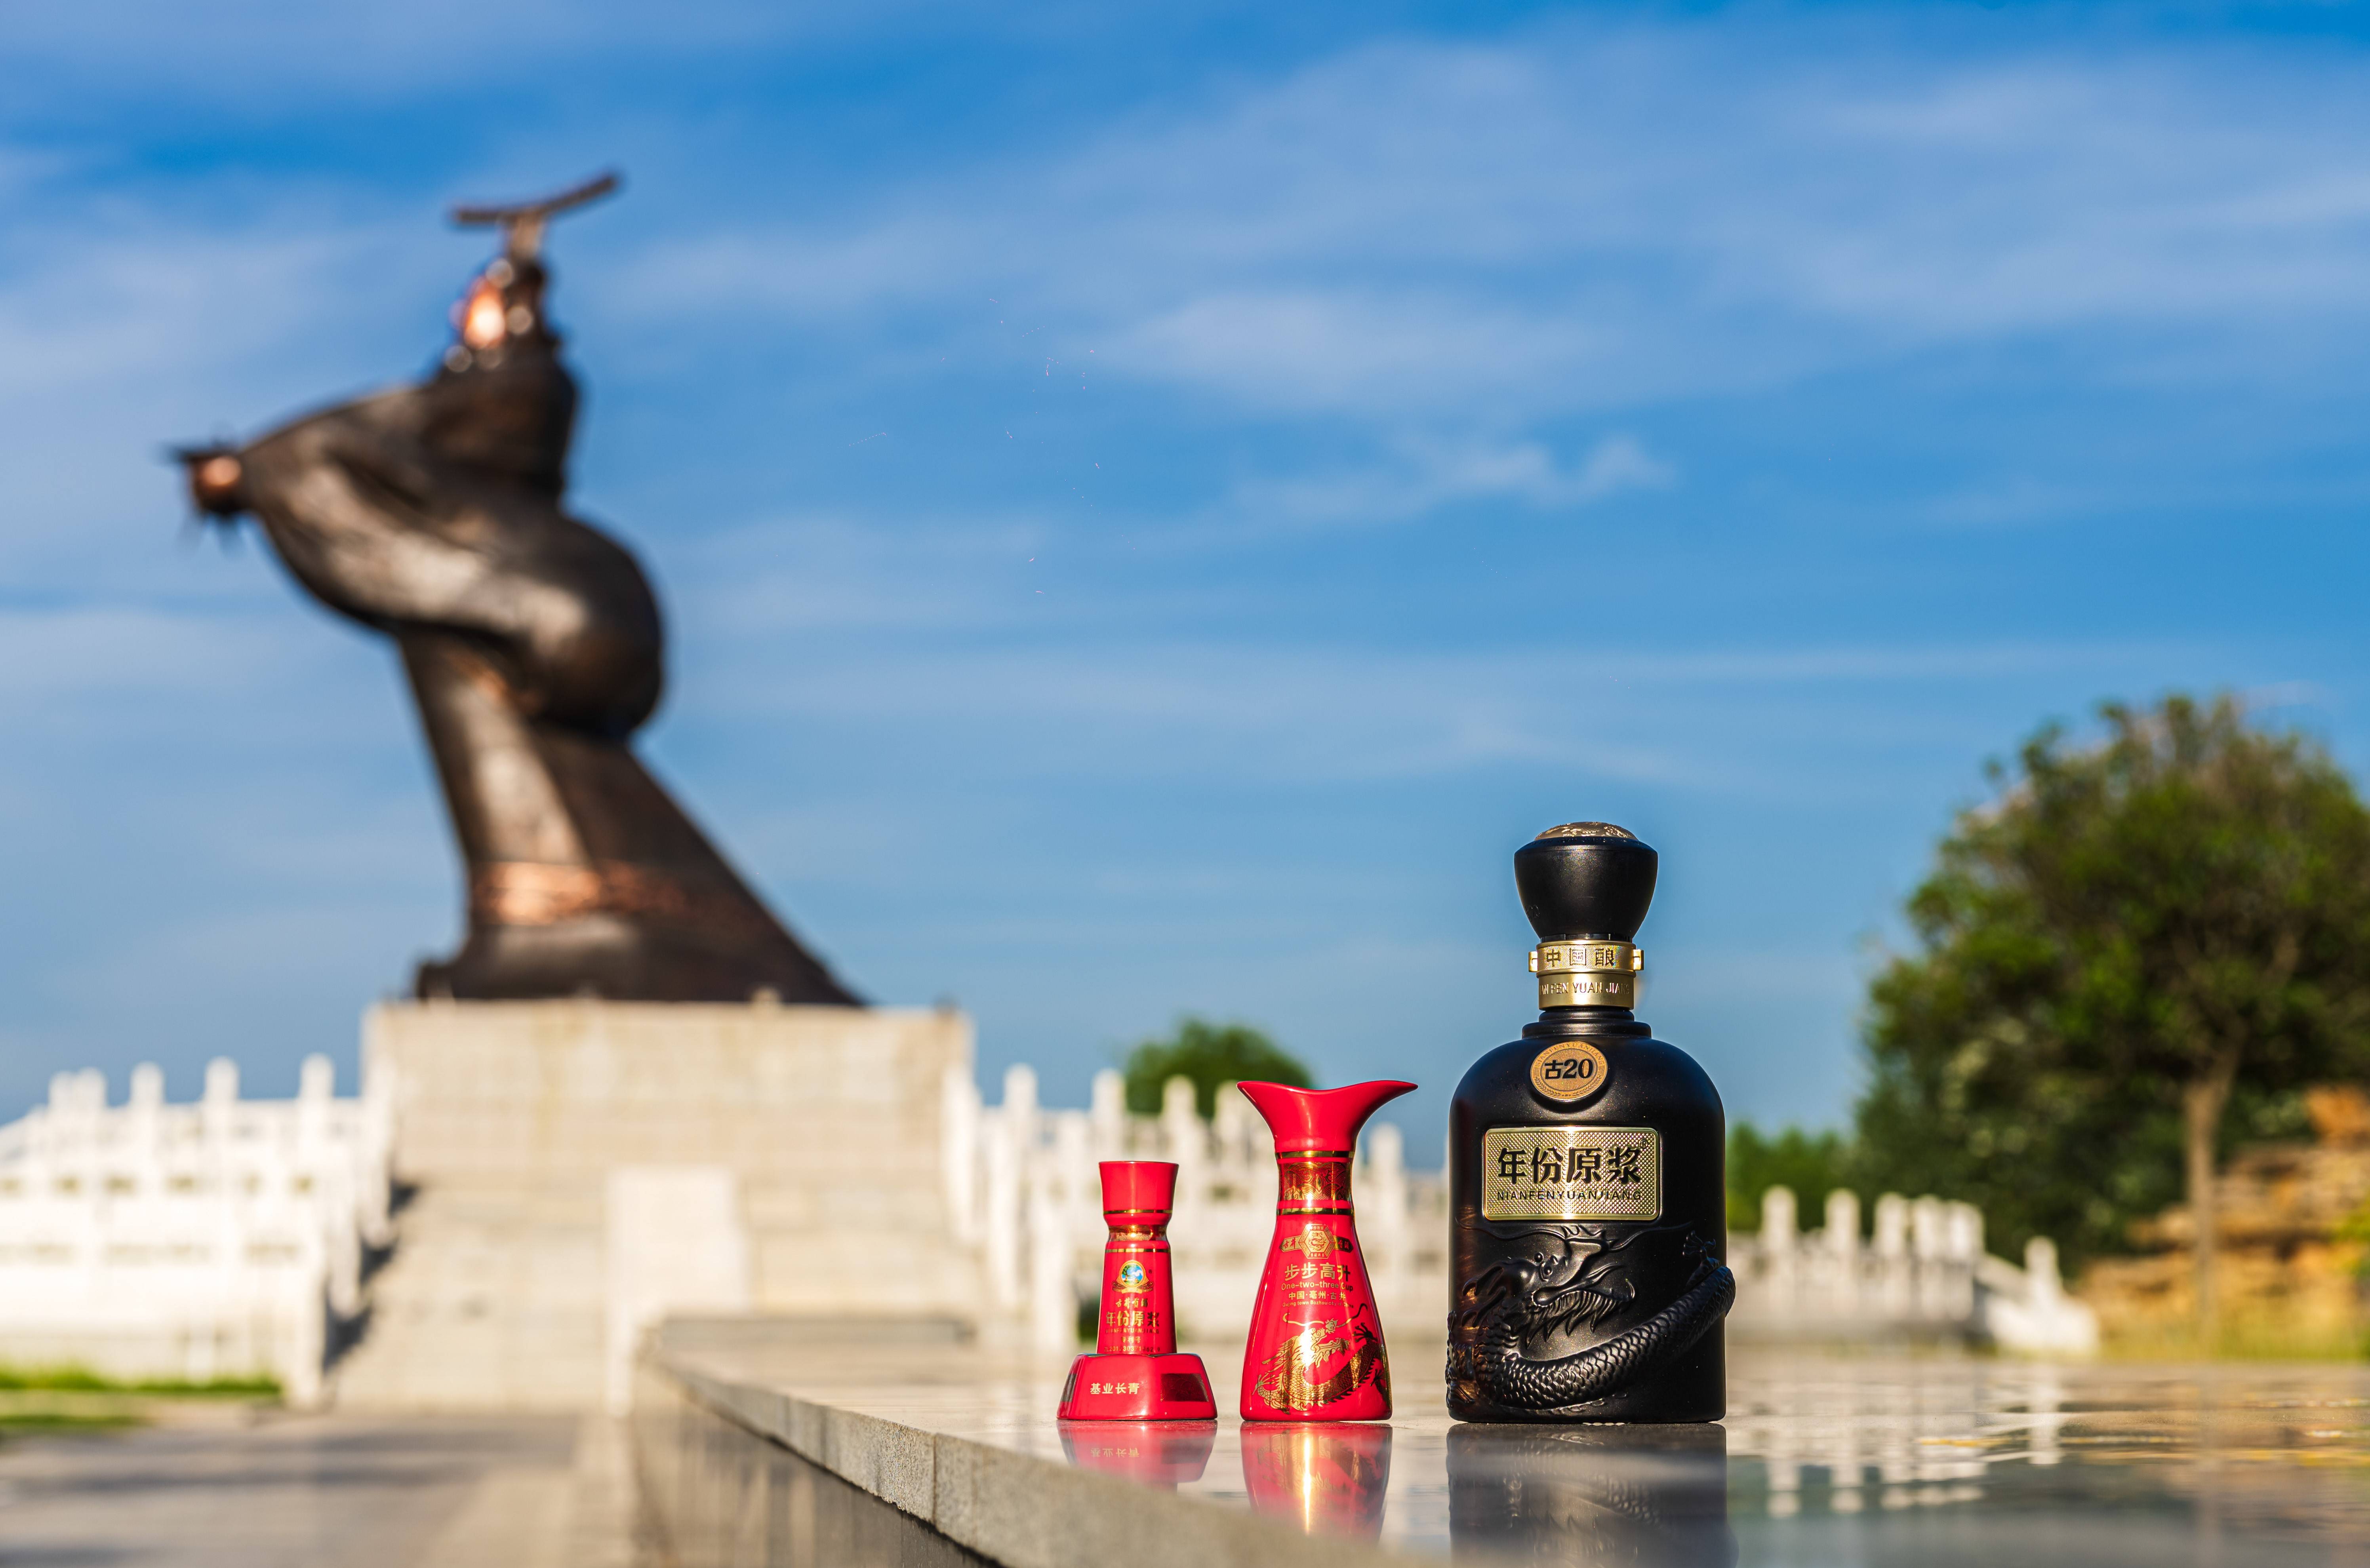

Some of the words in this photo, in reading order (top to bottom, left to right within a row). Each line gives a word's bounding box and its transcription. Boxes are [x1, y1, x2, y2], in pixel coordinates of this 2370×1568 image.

[1546, 948, 1615, 967] 中国酿
[1551, 982, 1569, 994] FEN
[1572, 982, 1603, 993] YUAN
[1545, 1059, 1594, 1079] 古20
[1497, 1146, 1641, 1184] 年份原浆
[1497, 1190, 1642, 1201] NIANFENYUANJIANG
[1284, 1262, 1351, 1282] 步步高升
[1281, 1280, 1339, 1290] One-two-three
[1341, 1282, 1353, 1292] Cup
[1106, 1310, 1160, 1327] 年份原浆
[1090, 1382, 1140, 1394] 基业长青
